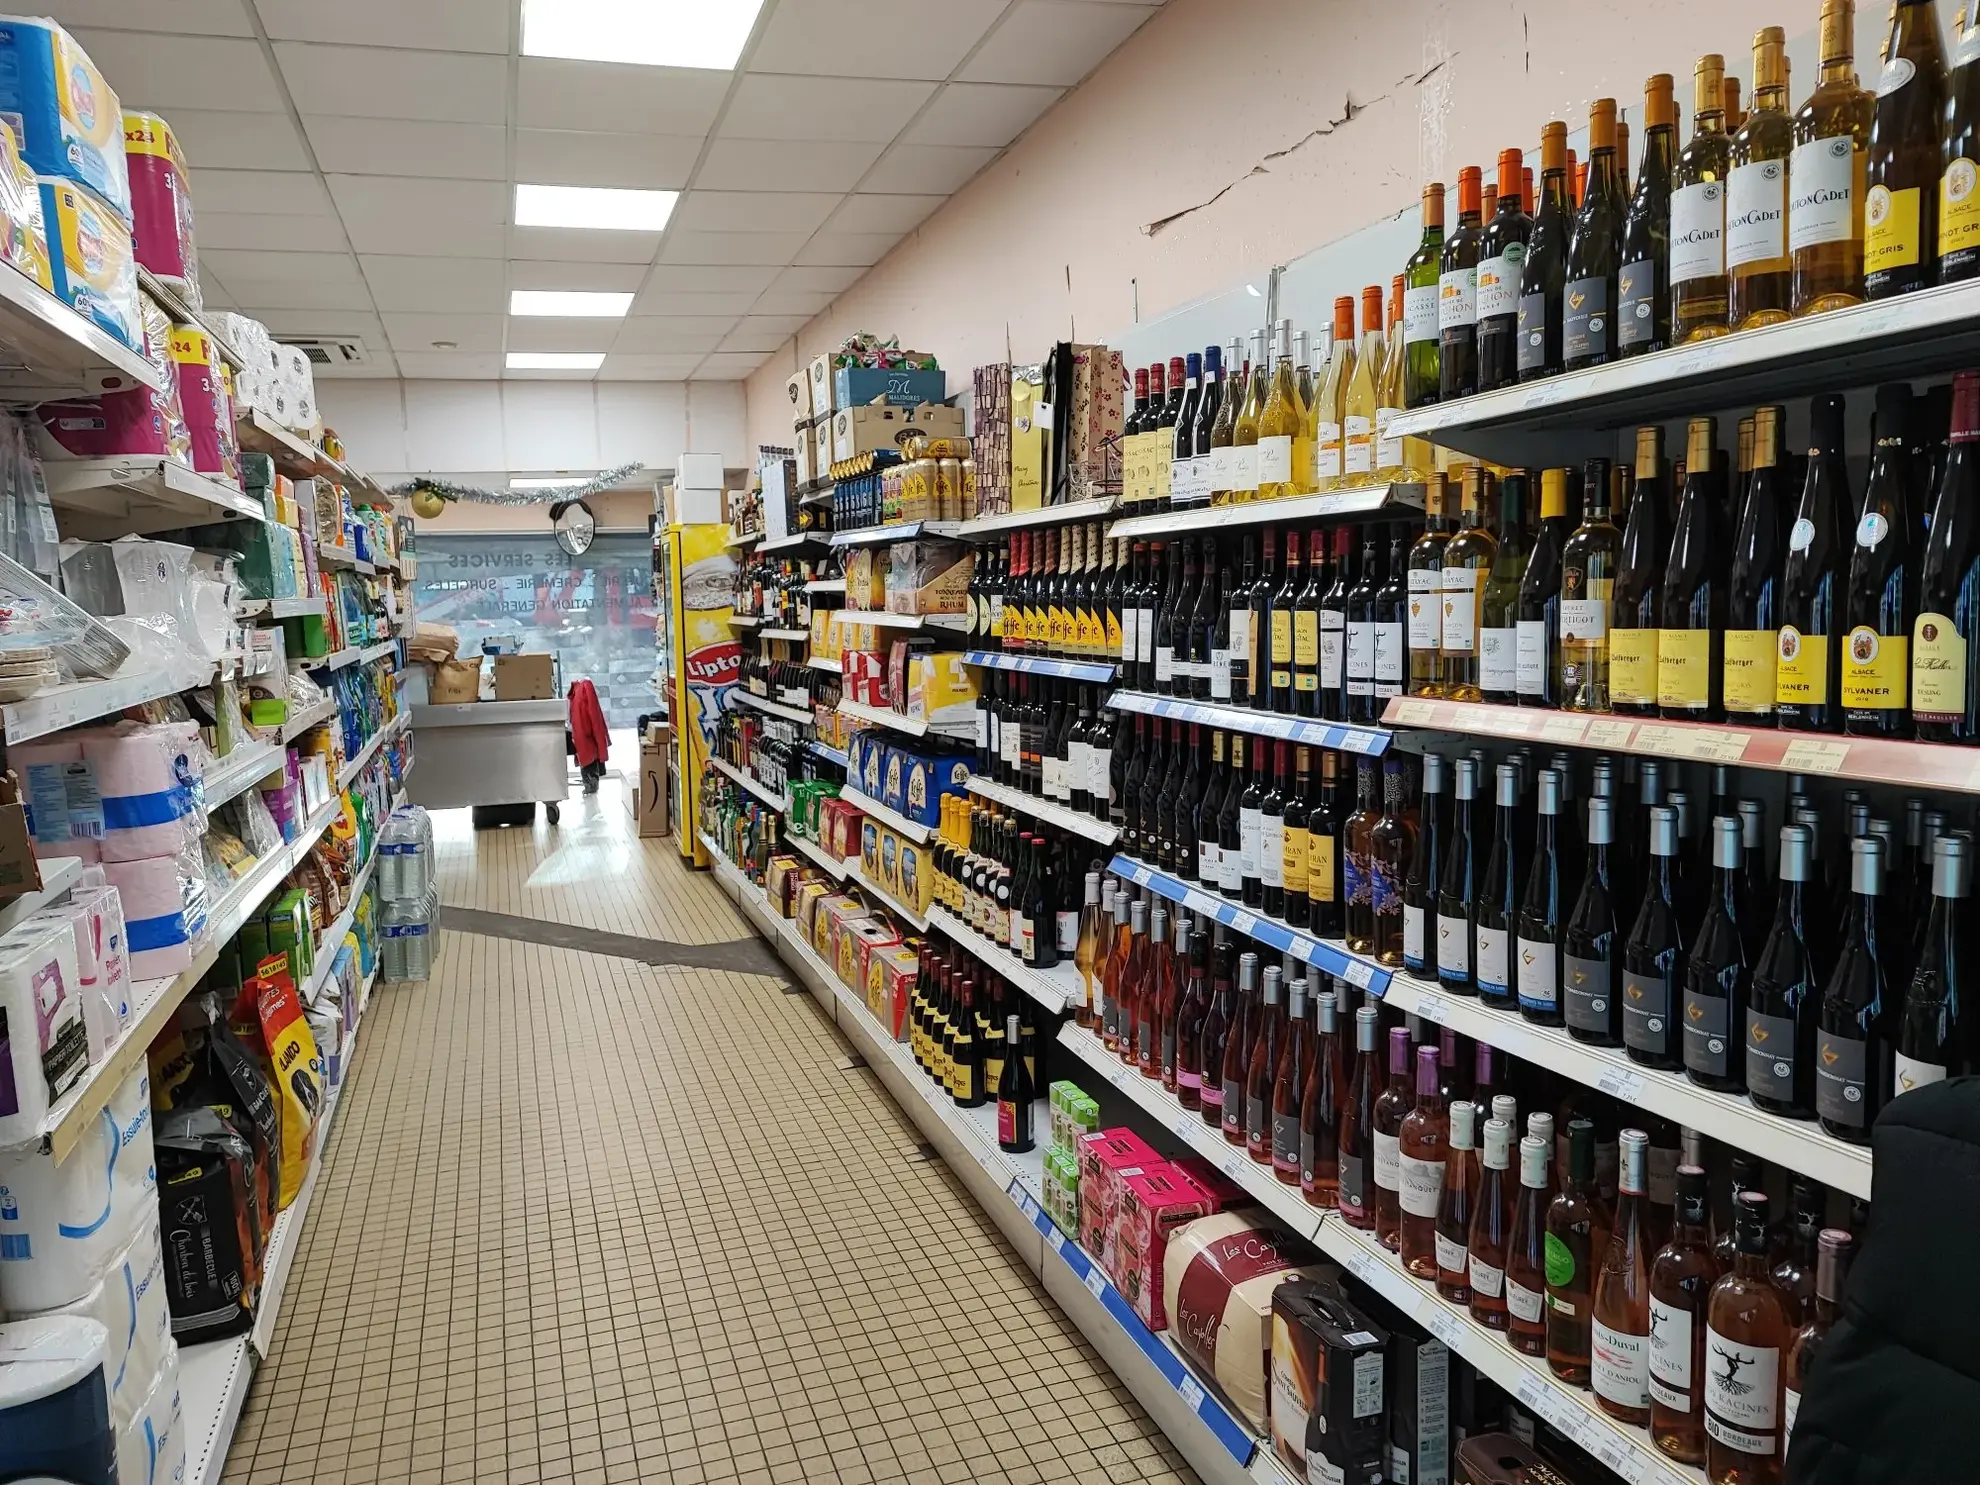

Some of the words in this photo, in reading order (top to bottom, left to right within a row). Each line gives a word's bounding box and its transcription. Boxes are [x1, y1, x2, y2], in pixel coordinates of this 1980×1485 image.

[1843, 687, 1890, 695] SYLVANER
[201, 1237, 216, 1281] BARBECUE
[1718, 1392, 1770, 1415] RACINES
[1708, 1416, 1720, 1437] BIO
